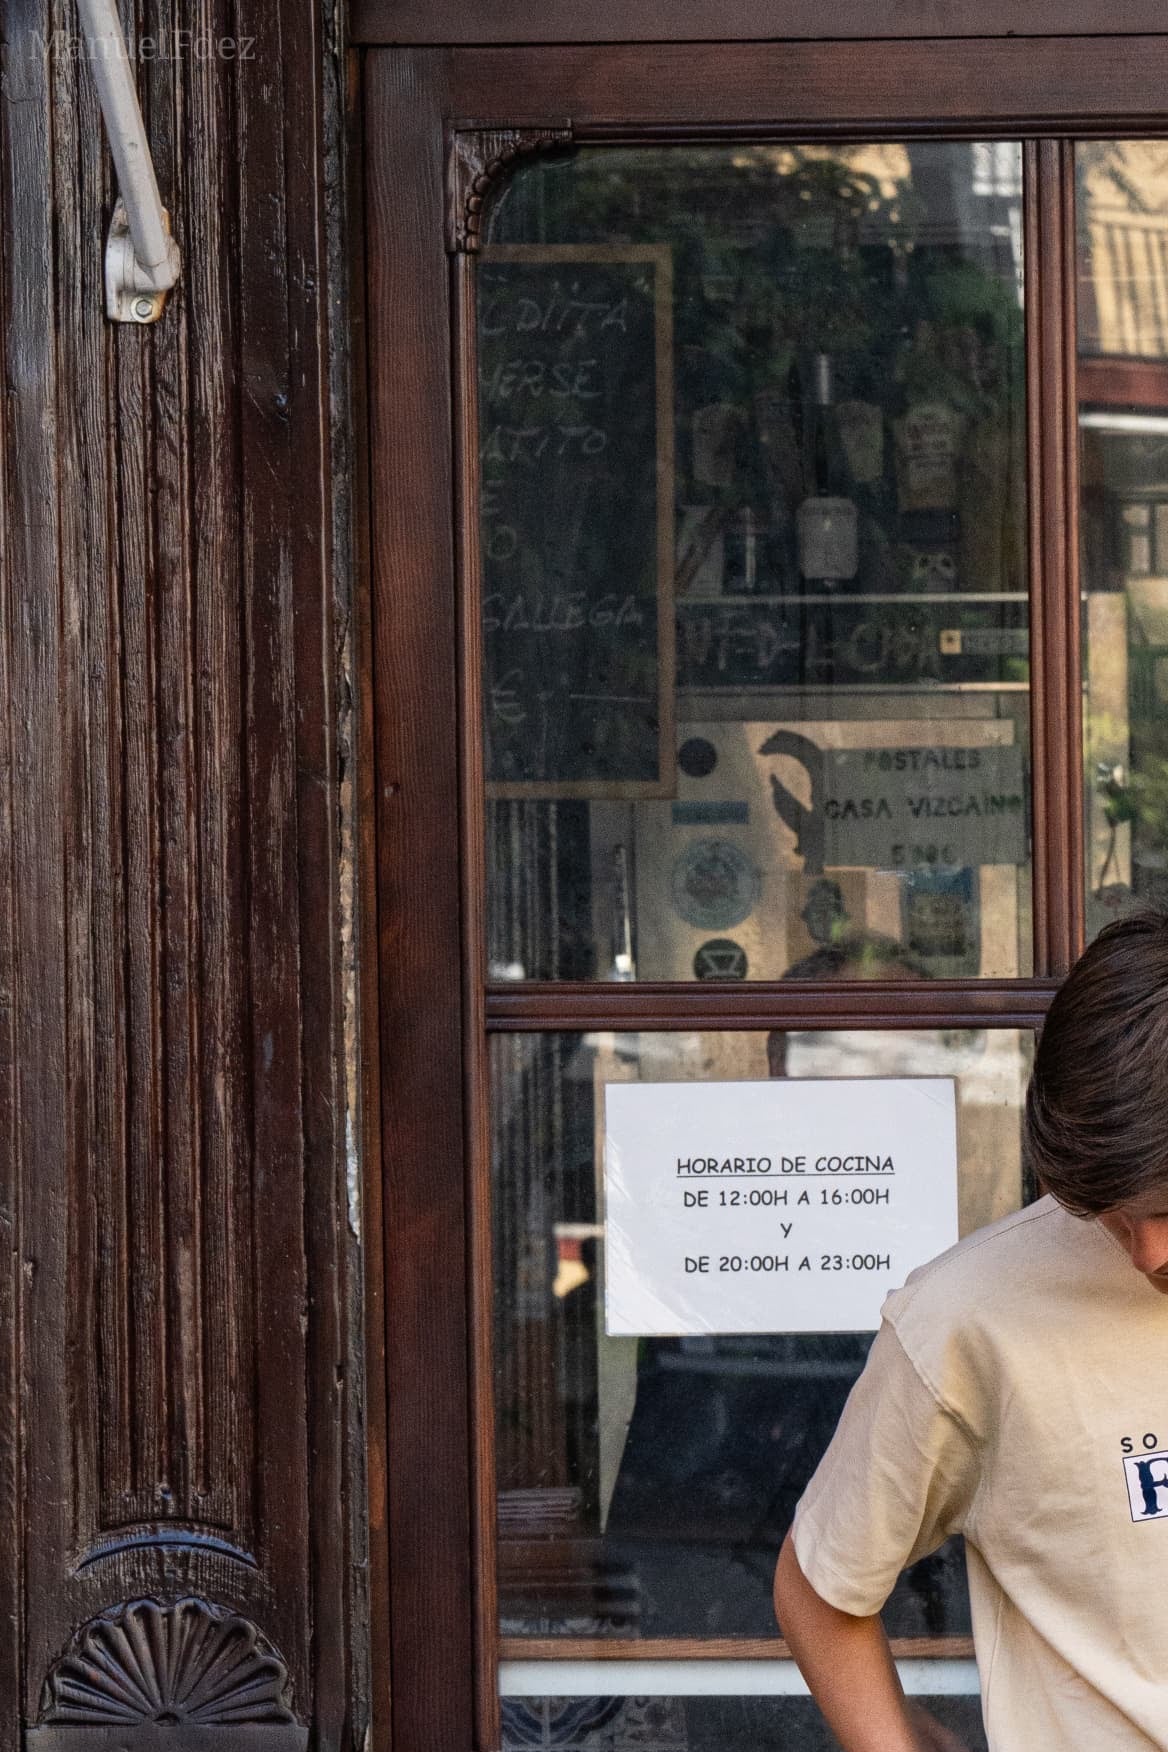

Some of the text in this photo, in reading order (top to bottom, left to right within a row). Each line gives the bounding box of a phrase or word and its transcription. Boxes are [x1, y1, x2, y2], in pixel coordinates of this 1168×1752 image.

[824, 798, 893, 820] CASA
[676, 1155, 895, 1175] HORARIO DE COCINA
[683, 1188, 890, 1208] DE 12:00H A 16:00H
[685, 1254, 891, 1273] DE 20:00H A 23:00H
